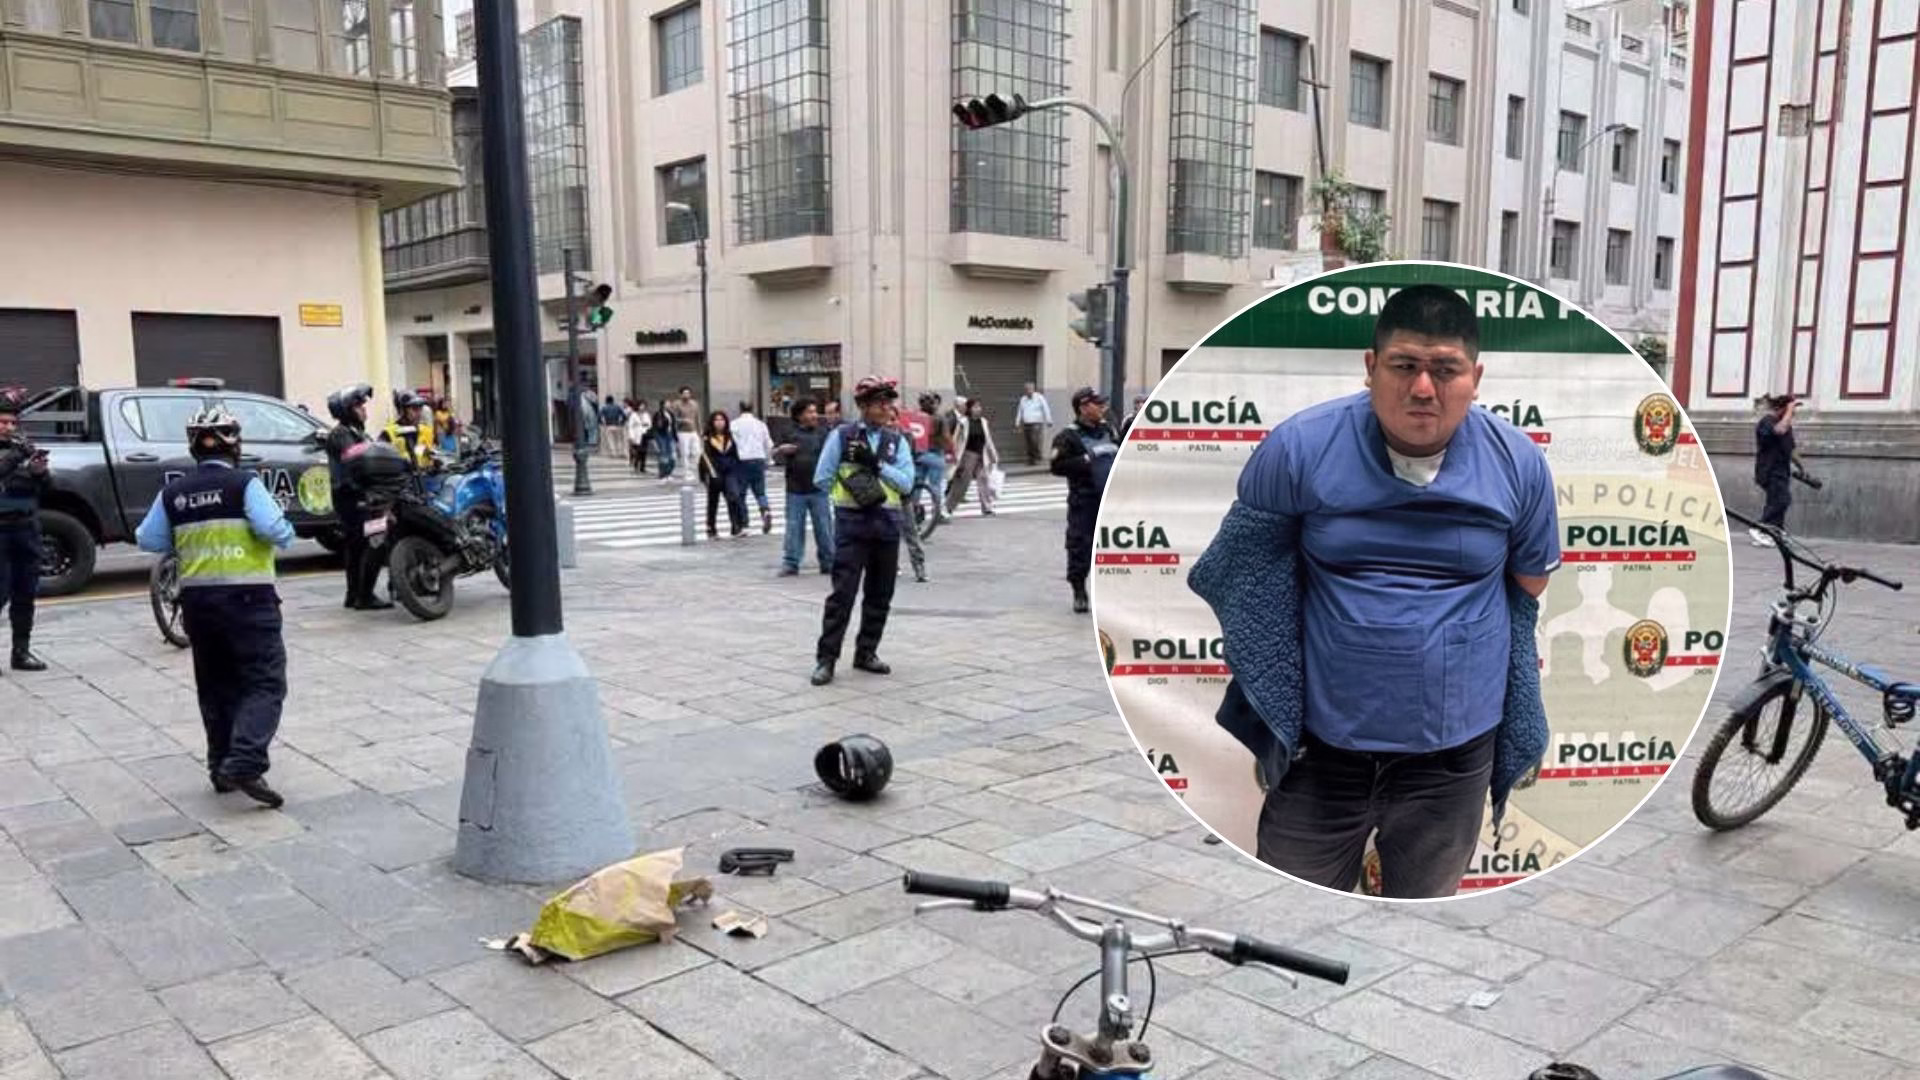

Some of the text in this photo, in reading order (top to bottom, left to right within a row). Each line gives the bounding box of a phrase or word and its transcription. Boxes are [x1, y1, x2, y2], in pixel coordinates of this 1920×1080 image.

[1307, 283, 1545, 319] COMRÍA
[968, 315, 1034, 331] McDonald's
[1145, 395, 1262, 424] OLICÍA
[1138, 430, 1267, 440] ERUANA
[1137, 443, 1222, 452] DIOS PATRIA
[1096, 520, 1171, 549] ICÍA
[1567, 520, 1690, 547] POLICÍA
[1097, 554, 1177, 563] UANA
[1098, 567, 1177, 575] PATRIA LEY
[1577, 563, 1693, 572] DIOS PATRIA LEY
[1132, 638, 1224, 659] POLIC
[1125, 665, 1225, 673] PERUA
[1559, 736, 1677, 763] POLICÍA
[1550, 767, 1661, 776] PERUAN
[1464, 848, 1541, 874] LICÍA
